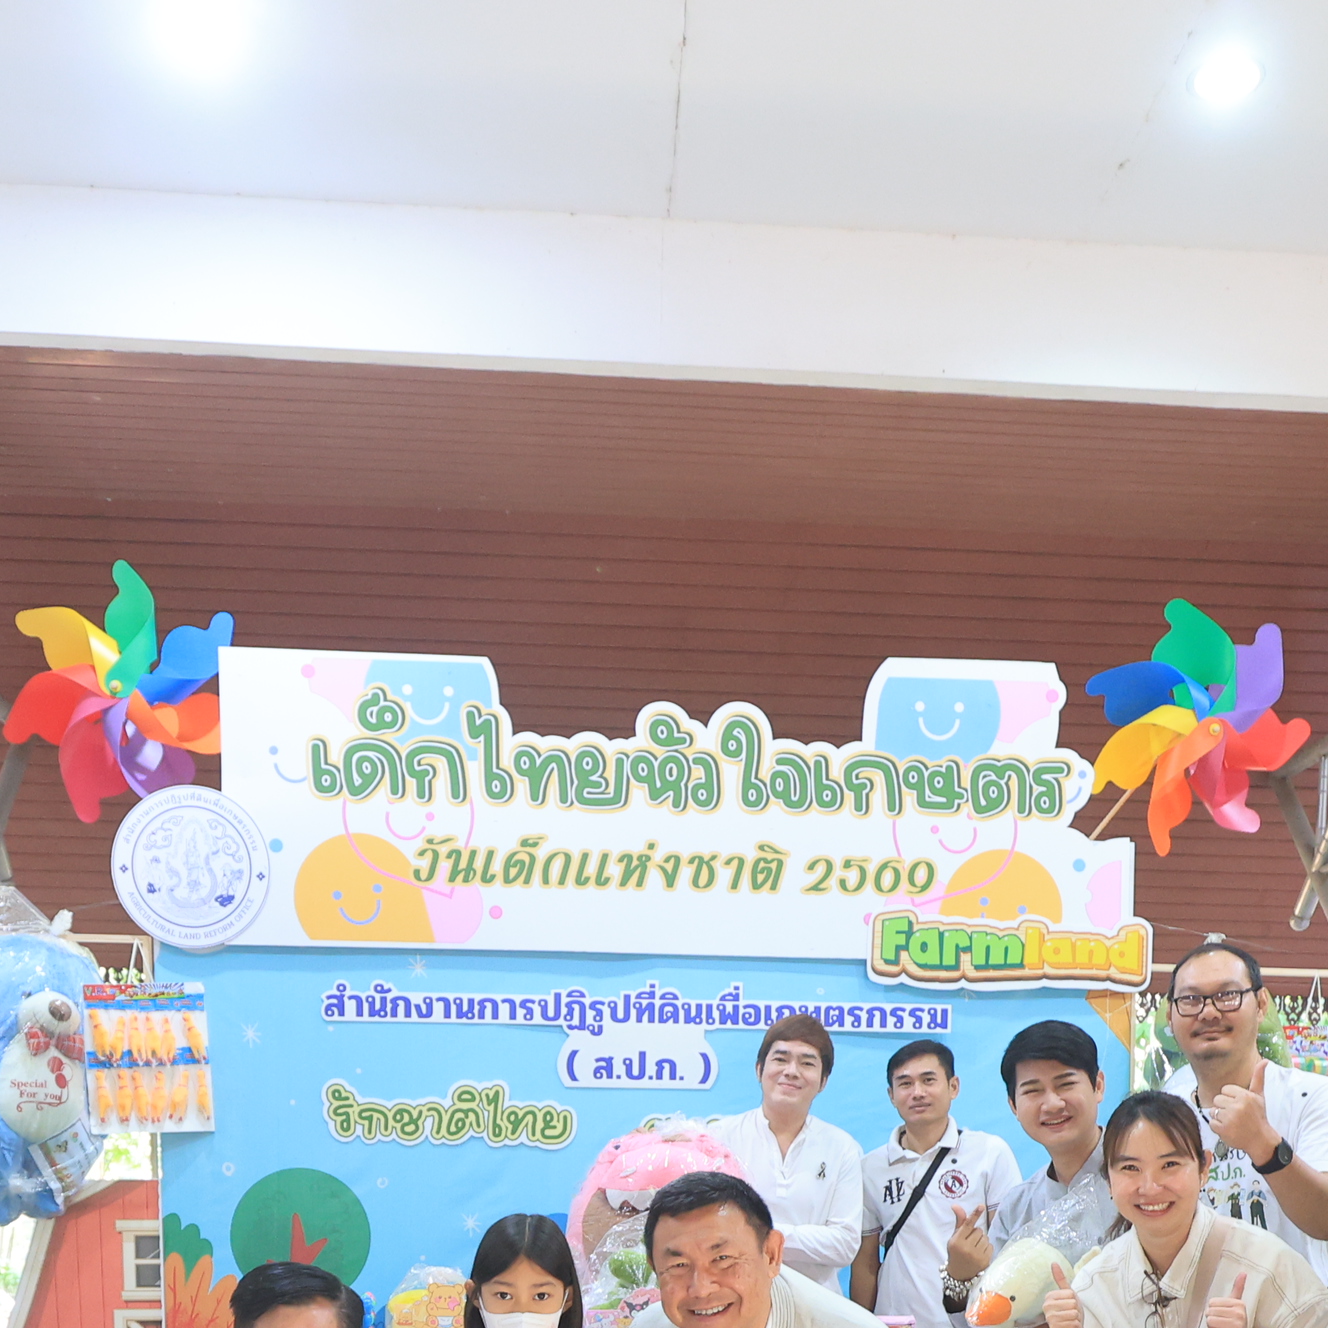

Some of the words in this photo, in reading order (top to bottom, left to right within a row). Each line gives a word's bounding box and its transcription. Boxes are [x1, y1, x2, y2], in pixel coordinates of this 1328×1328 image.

[309, 687, 1074, 818] เด็กไทยหัวใจเกษตร
[412, 834, 791, 895] วันเด็กแห่งชาติ
[802, 855, 942, 898] 2569
[127, 891, 176, 937] AGRICULTURAL
[178, 931, 202, 940] LAND
[203, 920, 235, 939] REFORM
[234, 897, 255, 922] OFFICE
[880, 915, 1144, 977] Farmland
[10, 1079, 47, 1091] Special
[19, 1090, 38, 1099] For
[327, 1084, 571, 1142] รักชาติไทย
